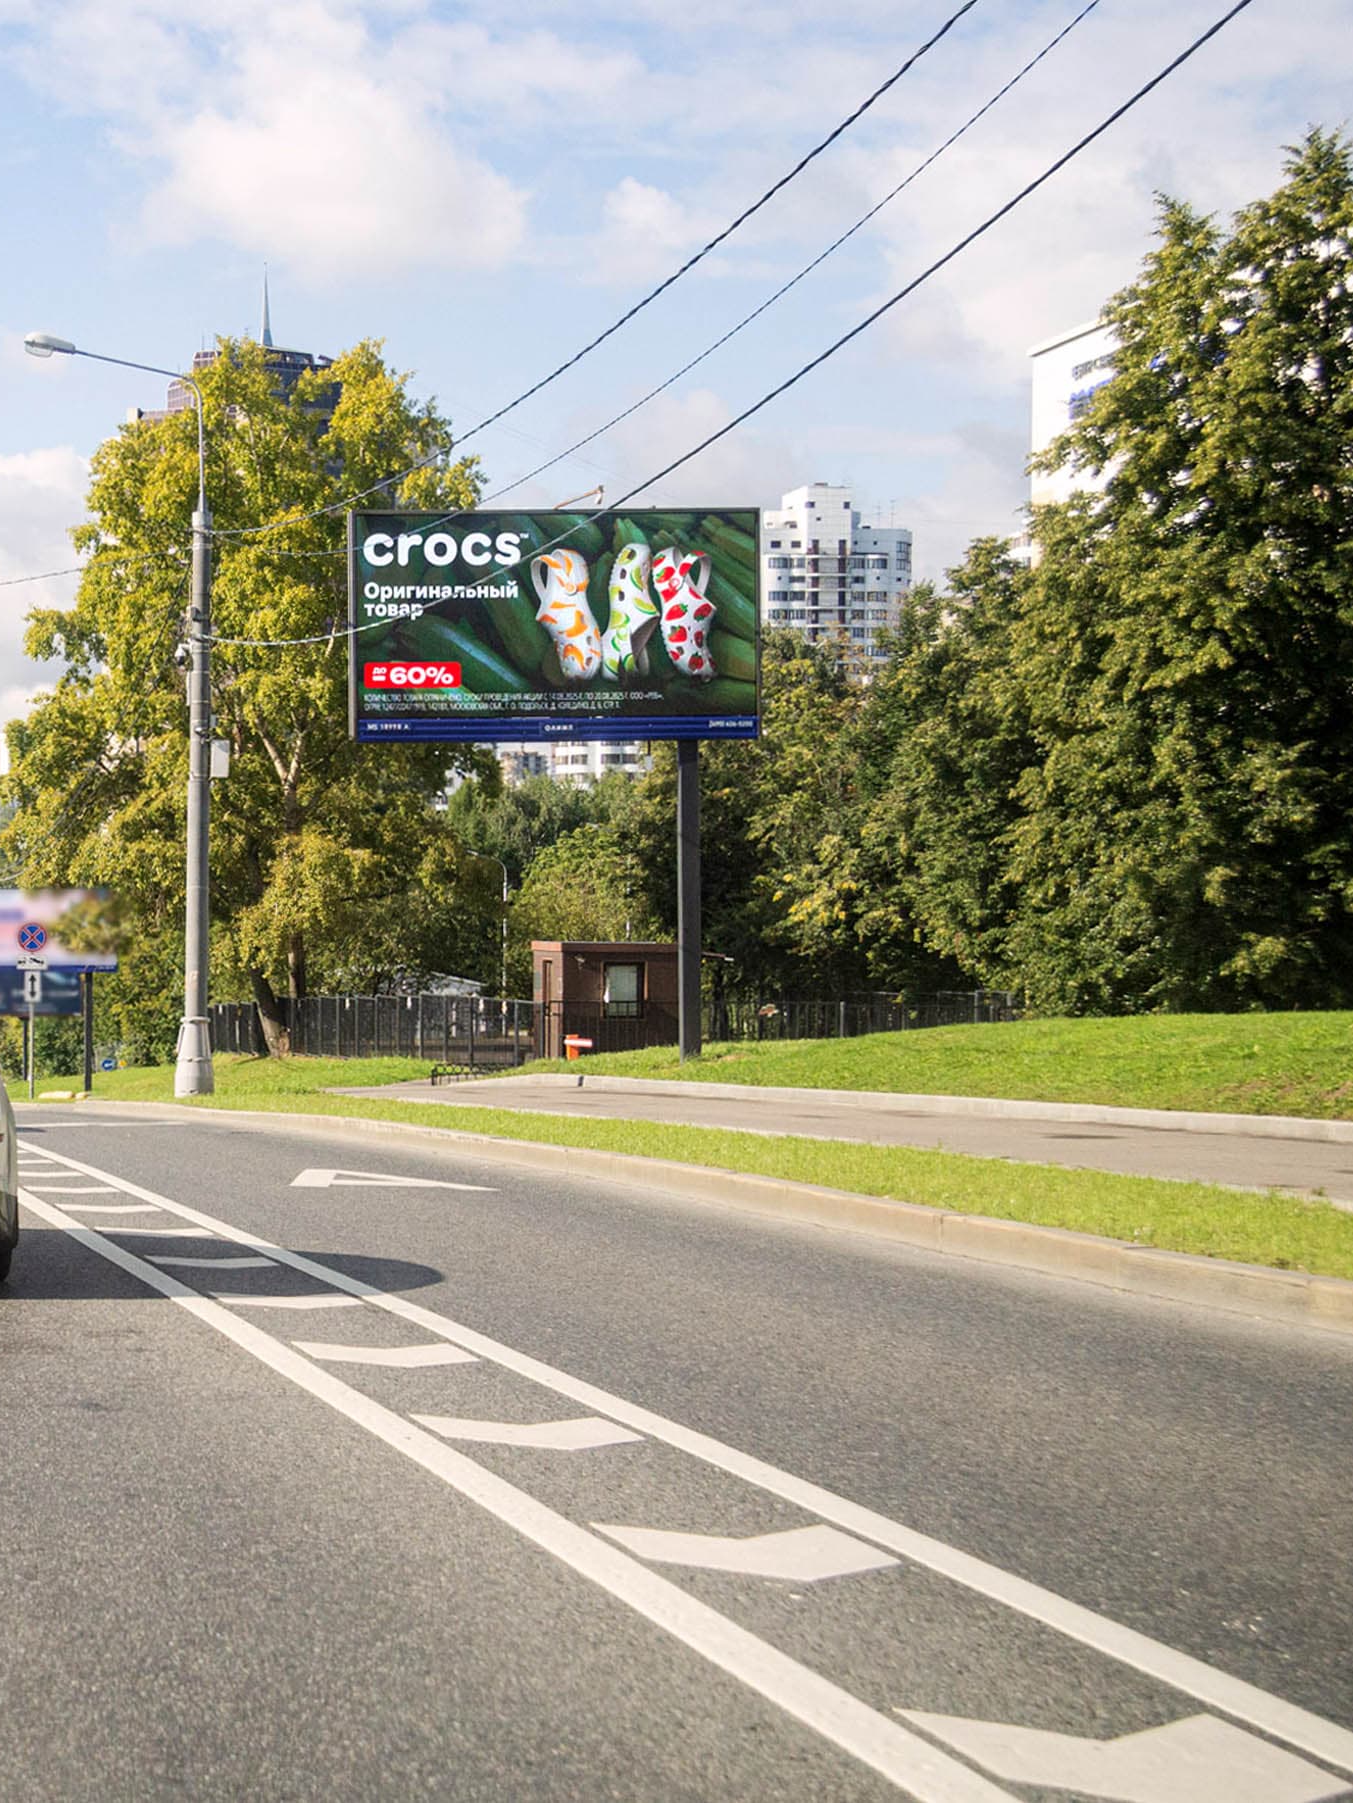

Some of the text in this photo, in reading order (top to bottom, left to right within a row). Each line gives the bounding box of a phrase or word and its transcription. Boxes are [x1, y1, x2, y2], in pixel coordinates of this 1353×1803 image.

[363, 533, 521, 566] crocs
[364, 581, 518, 602] Оригинальный
[364, 603, 423, 620] товар
